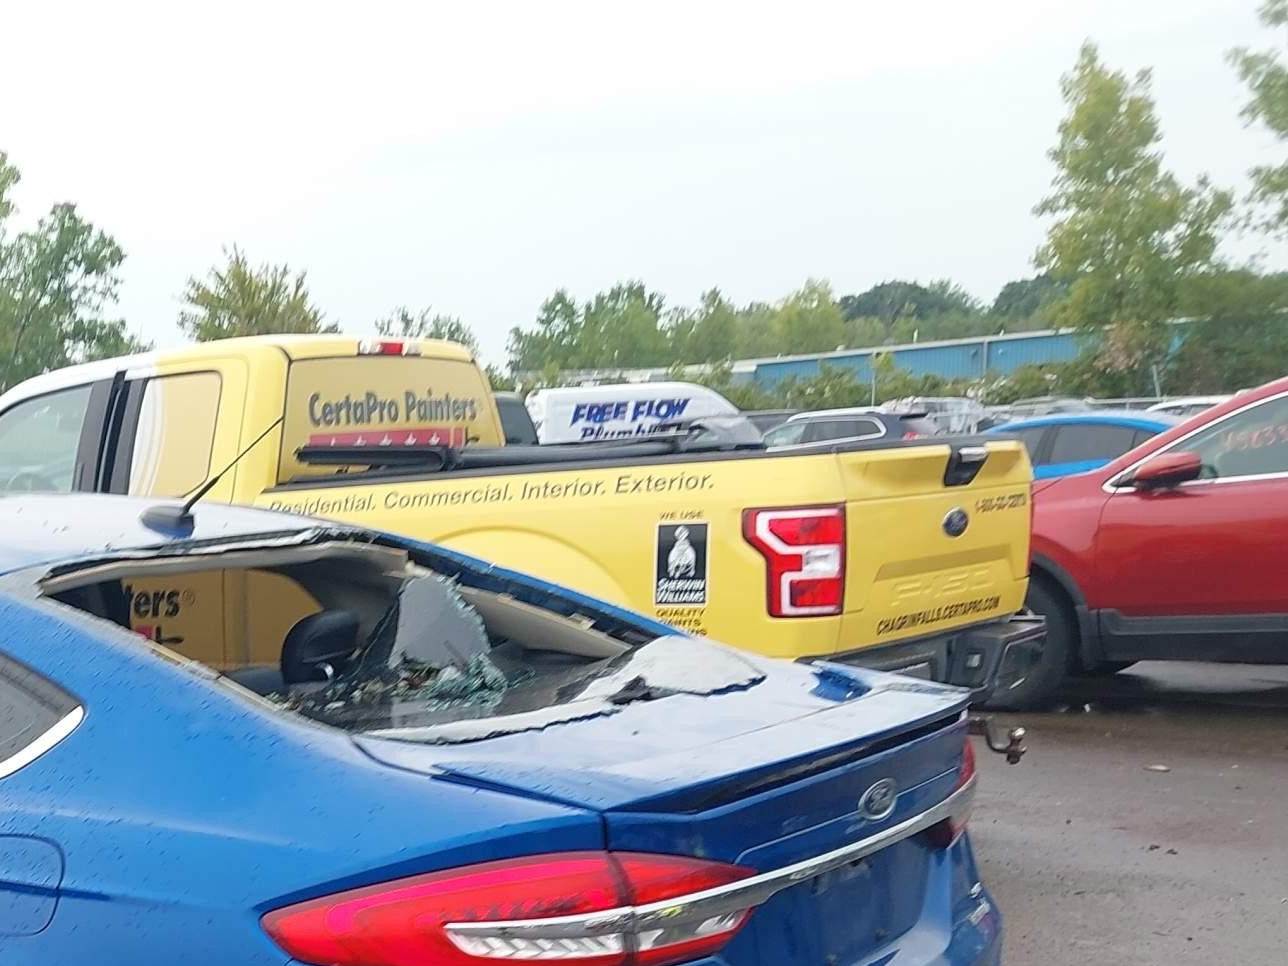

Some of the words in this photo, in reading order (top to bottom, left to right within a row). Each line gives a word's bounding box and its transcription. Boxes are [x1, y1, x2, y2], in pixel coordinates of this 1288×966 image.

[309, 392, 399, 427] CertaPro
[404, 387, 479, 422] Painters
[570, 401, 629, 427] FREE
[631, 399, 691, 422] FLOW
[383, 481, 514, 510] Commercial.
[520, 477, 607, 502] Interior.
[614, 471, 716, 496] Exterior.
